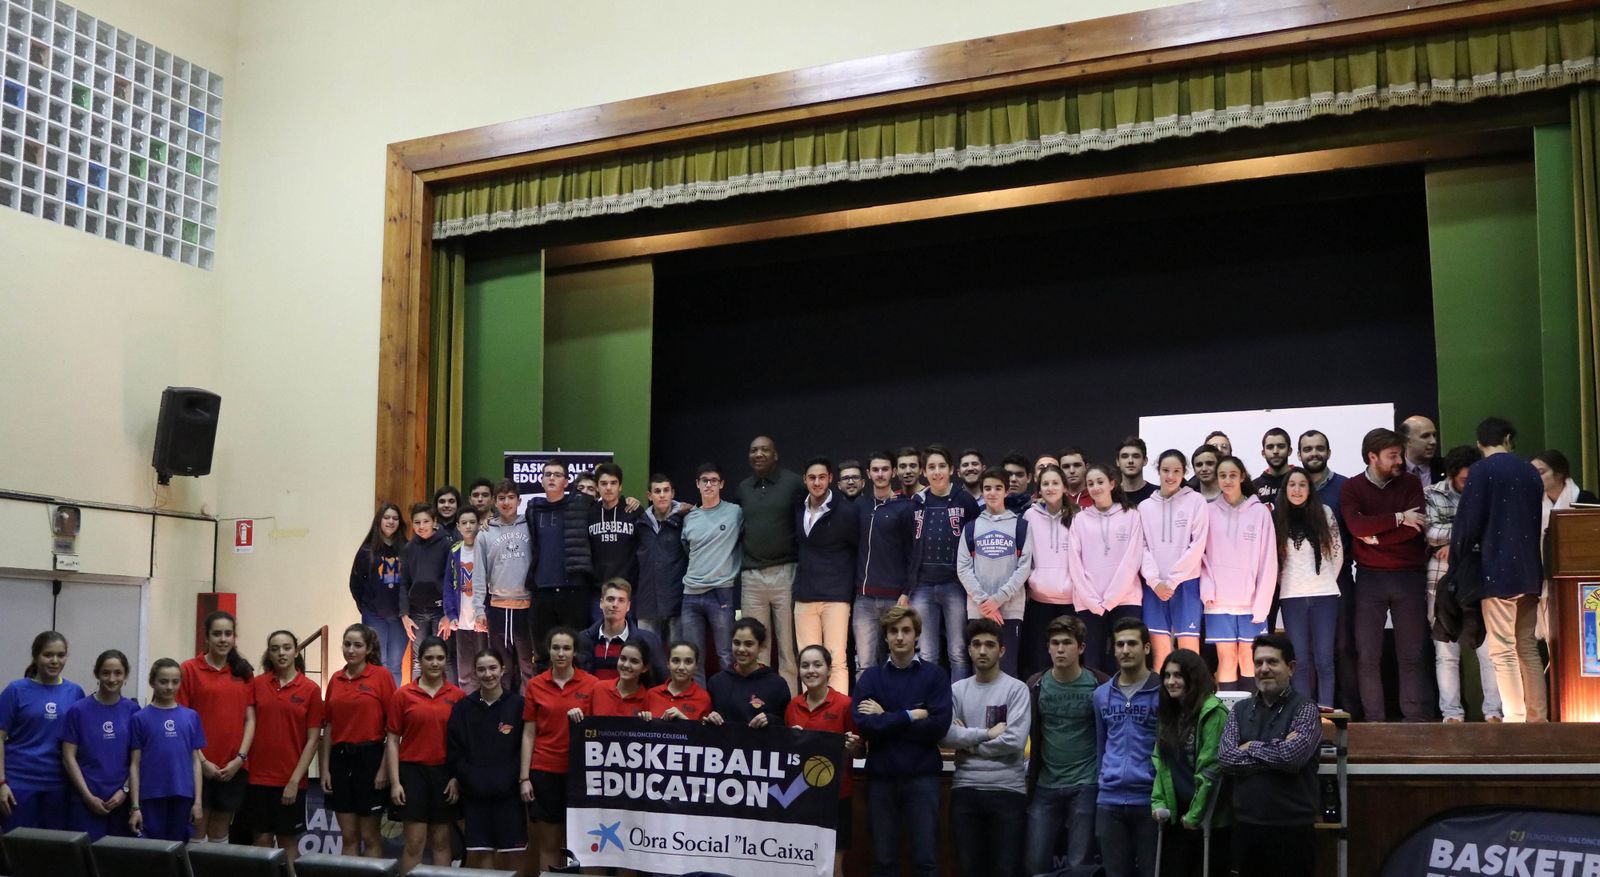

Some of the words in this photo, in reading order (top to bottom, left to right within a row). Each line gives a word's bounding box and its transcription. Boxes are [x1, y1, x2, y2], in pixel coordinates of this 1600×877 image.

[589, 521, 634, 535] PULL&BEAR
[601, 534, 618, 542] 1991
[976, 538, 1014, 547] PULL&BEAR
[1102, 704, 1159, 717] PULL&BEA
[585, 741, 786, 779] BASKETBALL
[787, 753, 801, 767] IS
[586, 771, 769, 808] EDUCATION
[629, 827, 668, 850] Obra
[672, 831, 730, 853] Social
